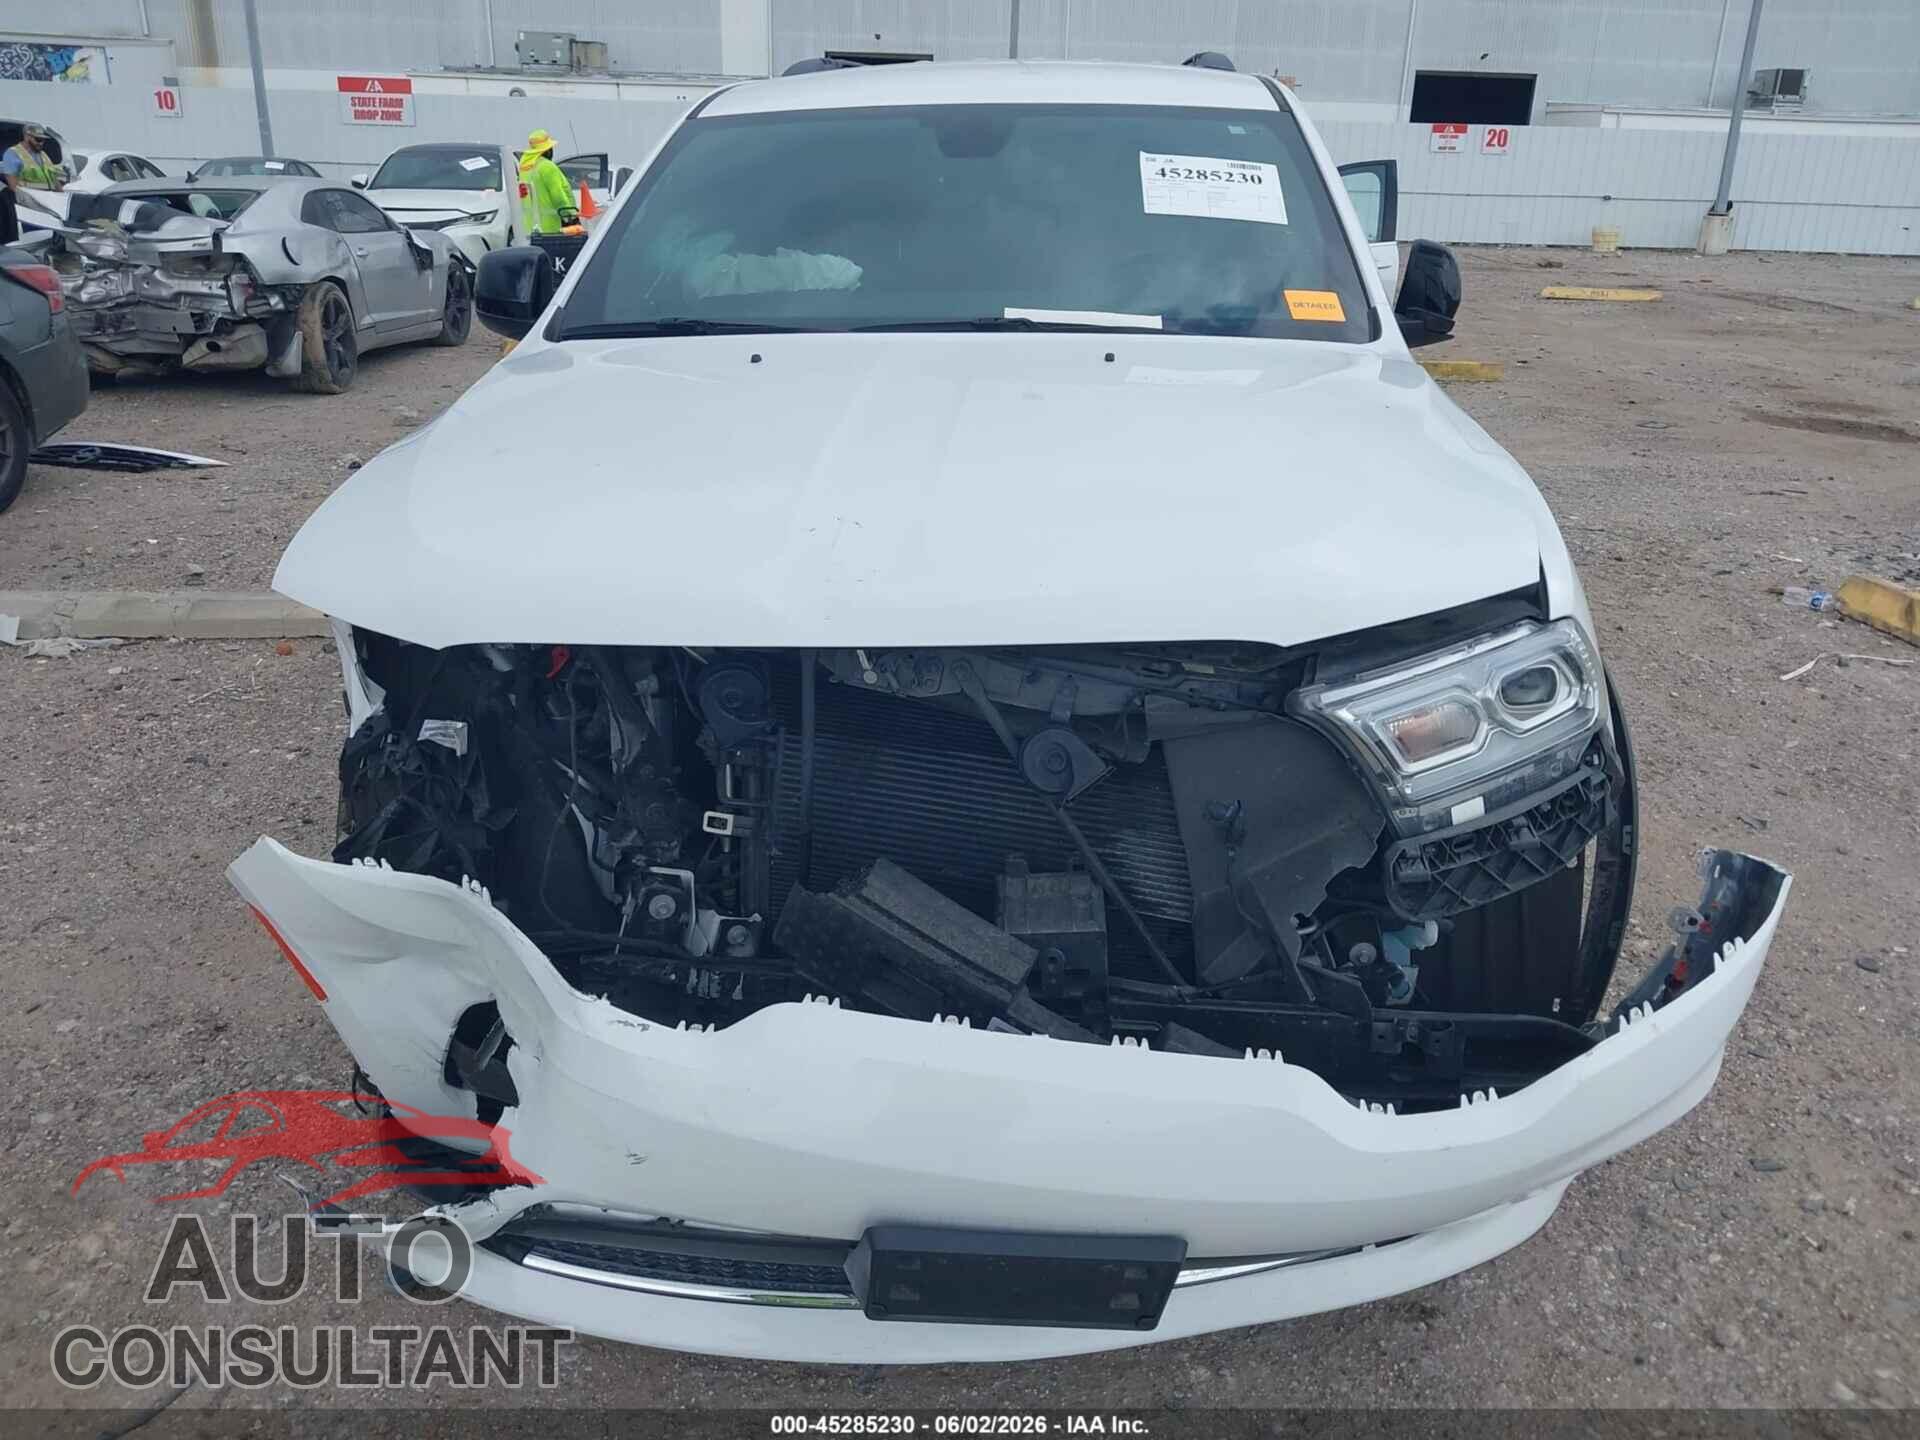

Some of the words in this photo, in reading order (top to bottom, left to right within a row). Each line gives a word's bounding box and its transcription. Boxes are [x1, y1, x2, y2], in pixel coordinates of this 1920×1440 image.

[154, 90, 175, 110] 10
[350, 96, 377, 108] STATE
[353, 109, 379, 121] DROP
[380, 110, 403, 122] ZONE
[1486, 128, 1509, 148] 20
[1154, 167, 1263, 185] 45285230
